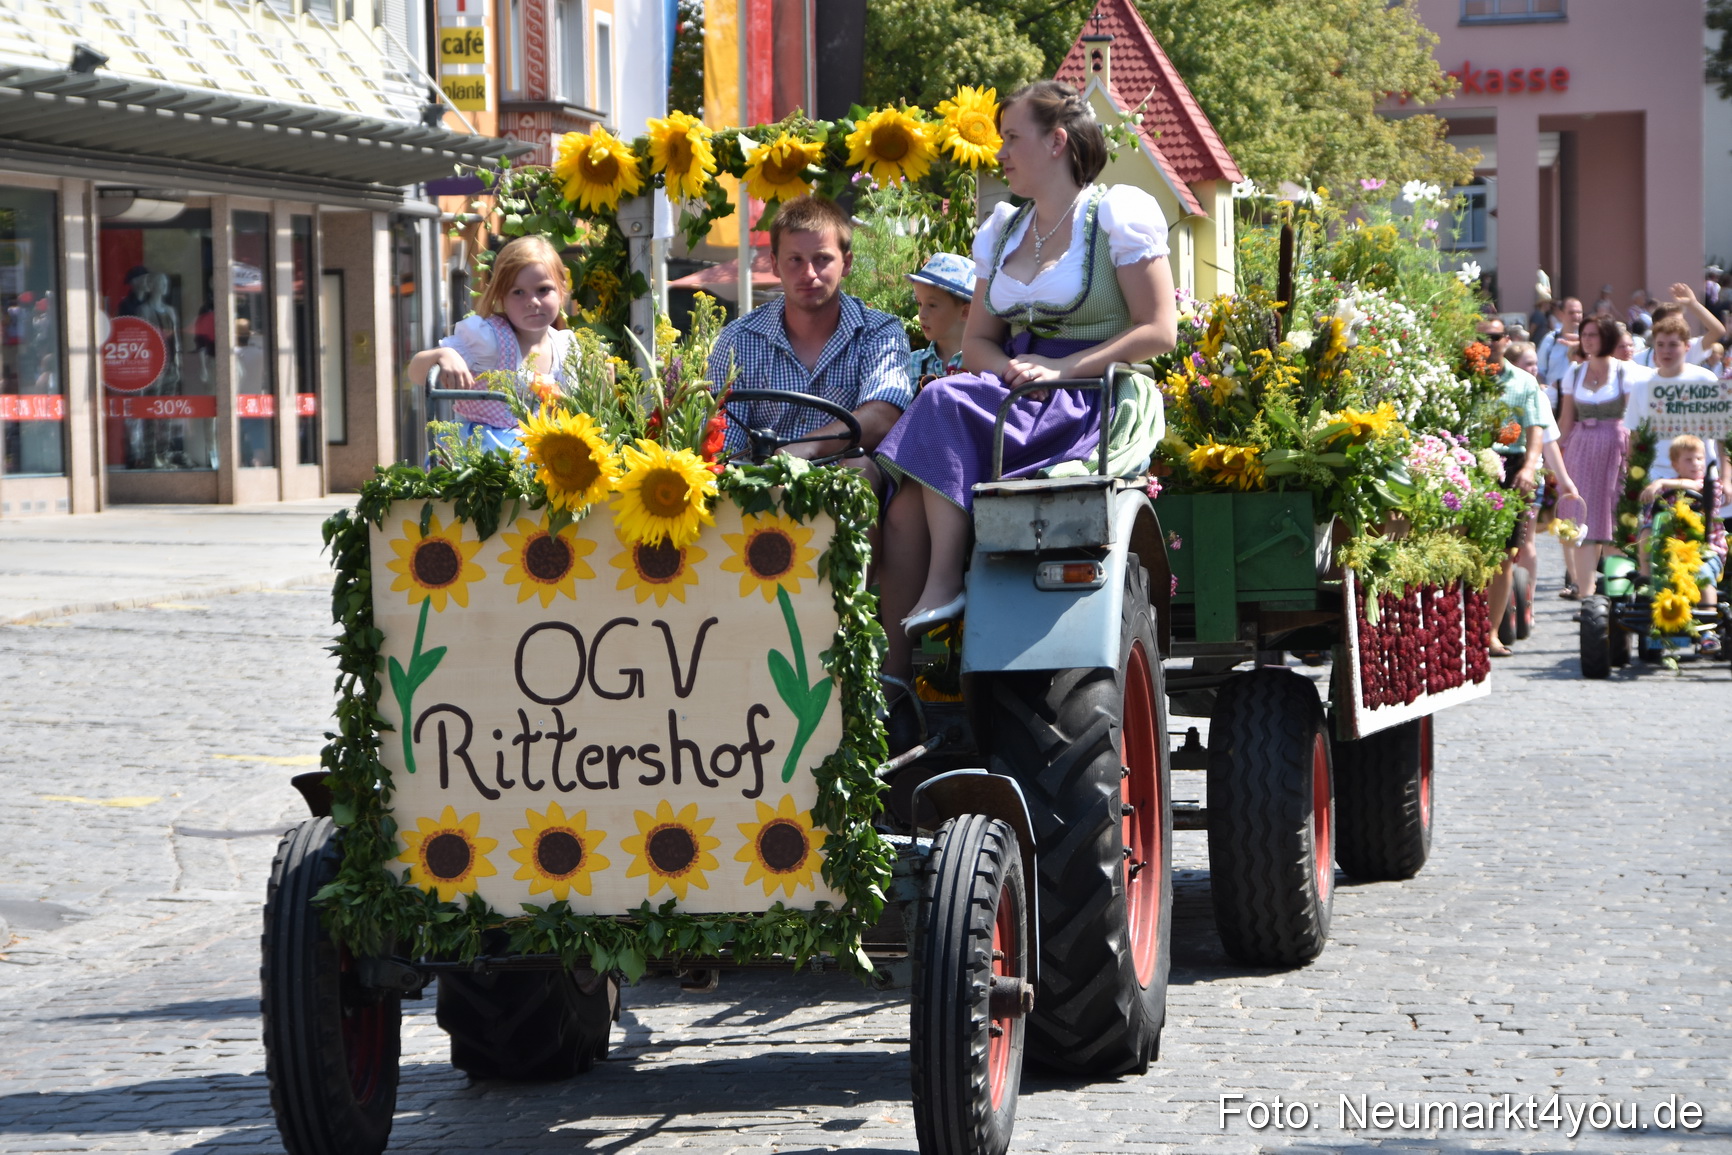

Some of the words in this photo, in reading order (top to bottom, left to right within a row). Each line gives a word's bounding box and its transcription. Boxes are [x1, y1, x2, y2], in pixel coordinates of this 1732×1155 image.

[441, 30, 483, 56] café
[104, 342, 150, 359] 25%
[108, 398, 133, 417] LE
[146, 400, 193, 415] -30%
[514, 616, 719, 705] OGV
[413, 703, 775, 800] Rittershof
